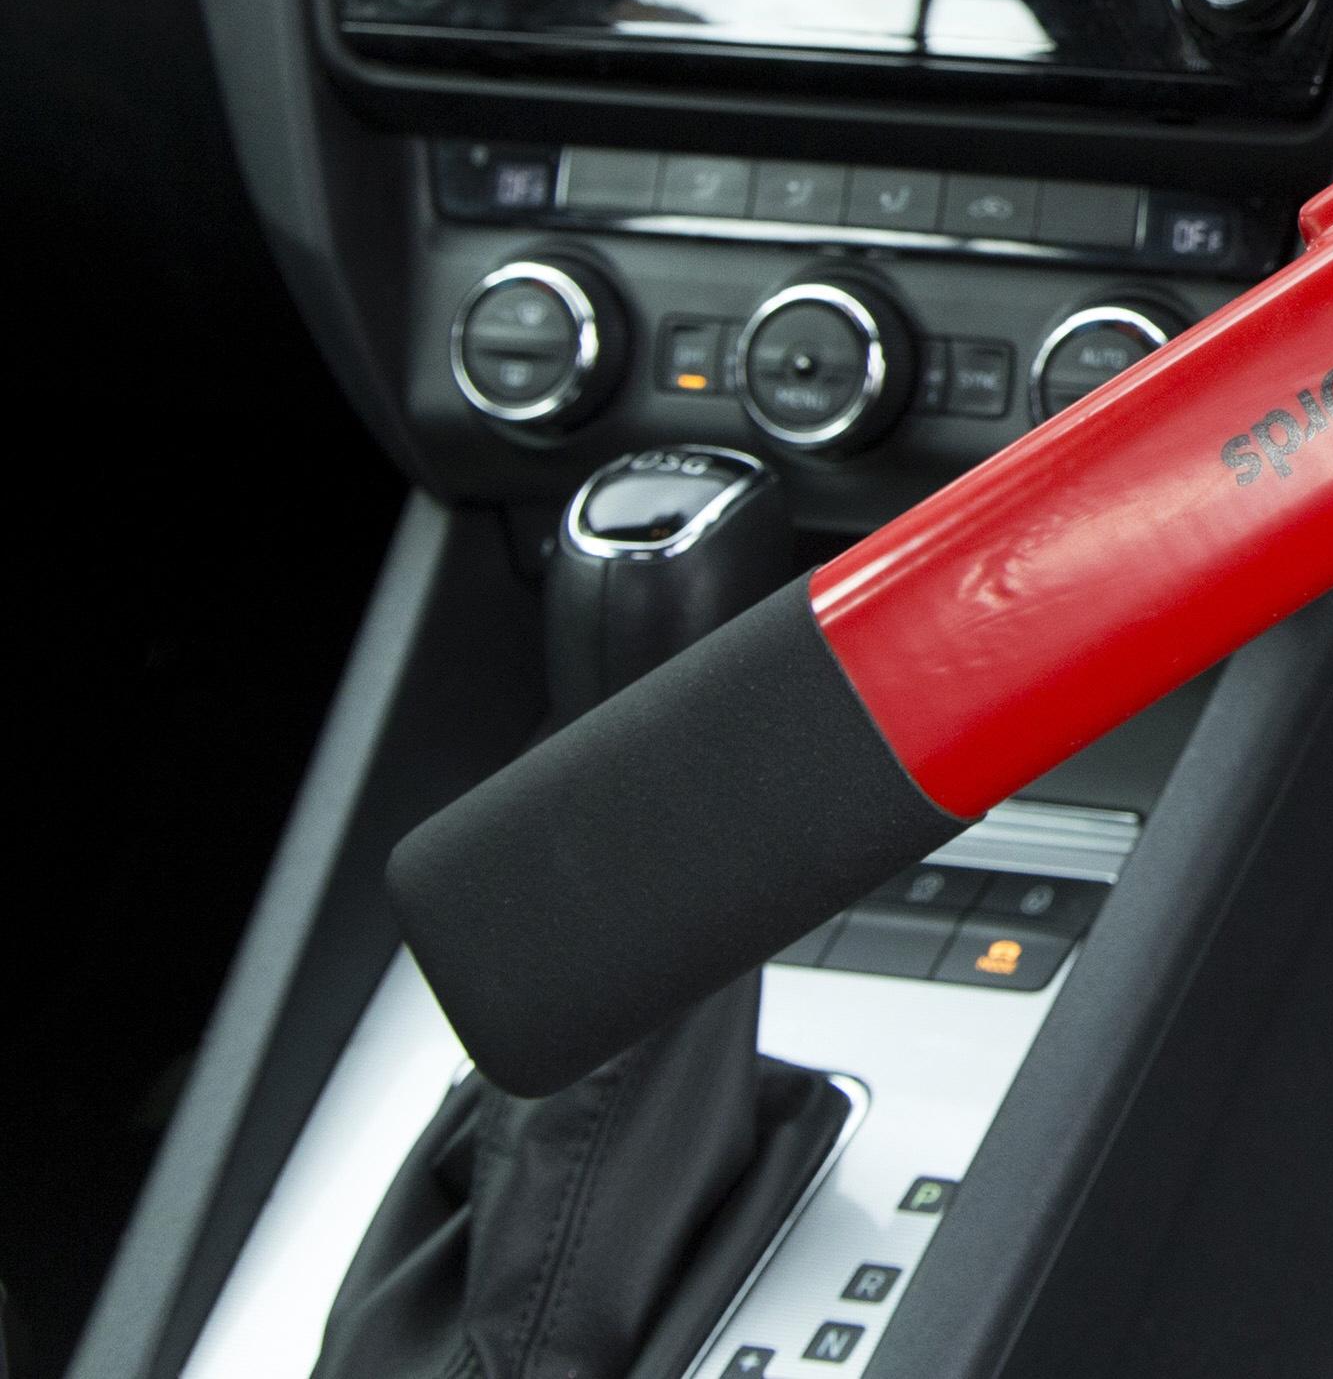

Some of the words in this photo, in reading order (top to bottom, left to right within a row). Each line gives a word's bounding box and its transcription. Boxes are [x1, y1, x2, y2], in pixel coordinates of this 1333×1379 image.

[912, 1183, 941, 1208] P
[855, 1271, 885, 1297] R
[816, 1329, 849, 1358] N
